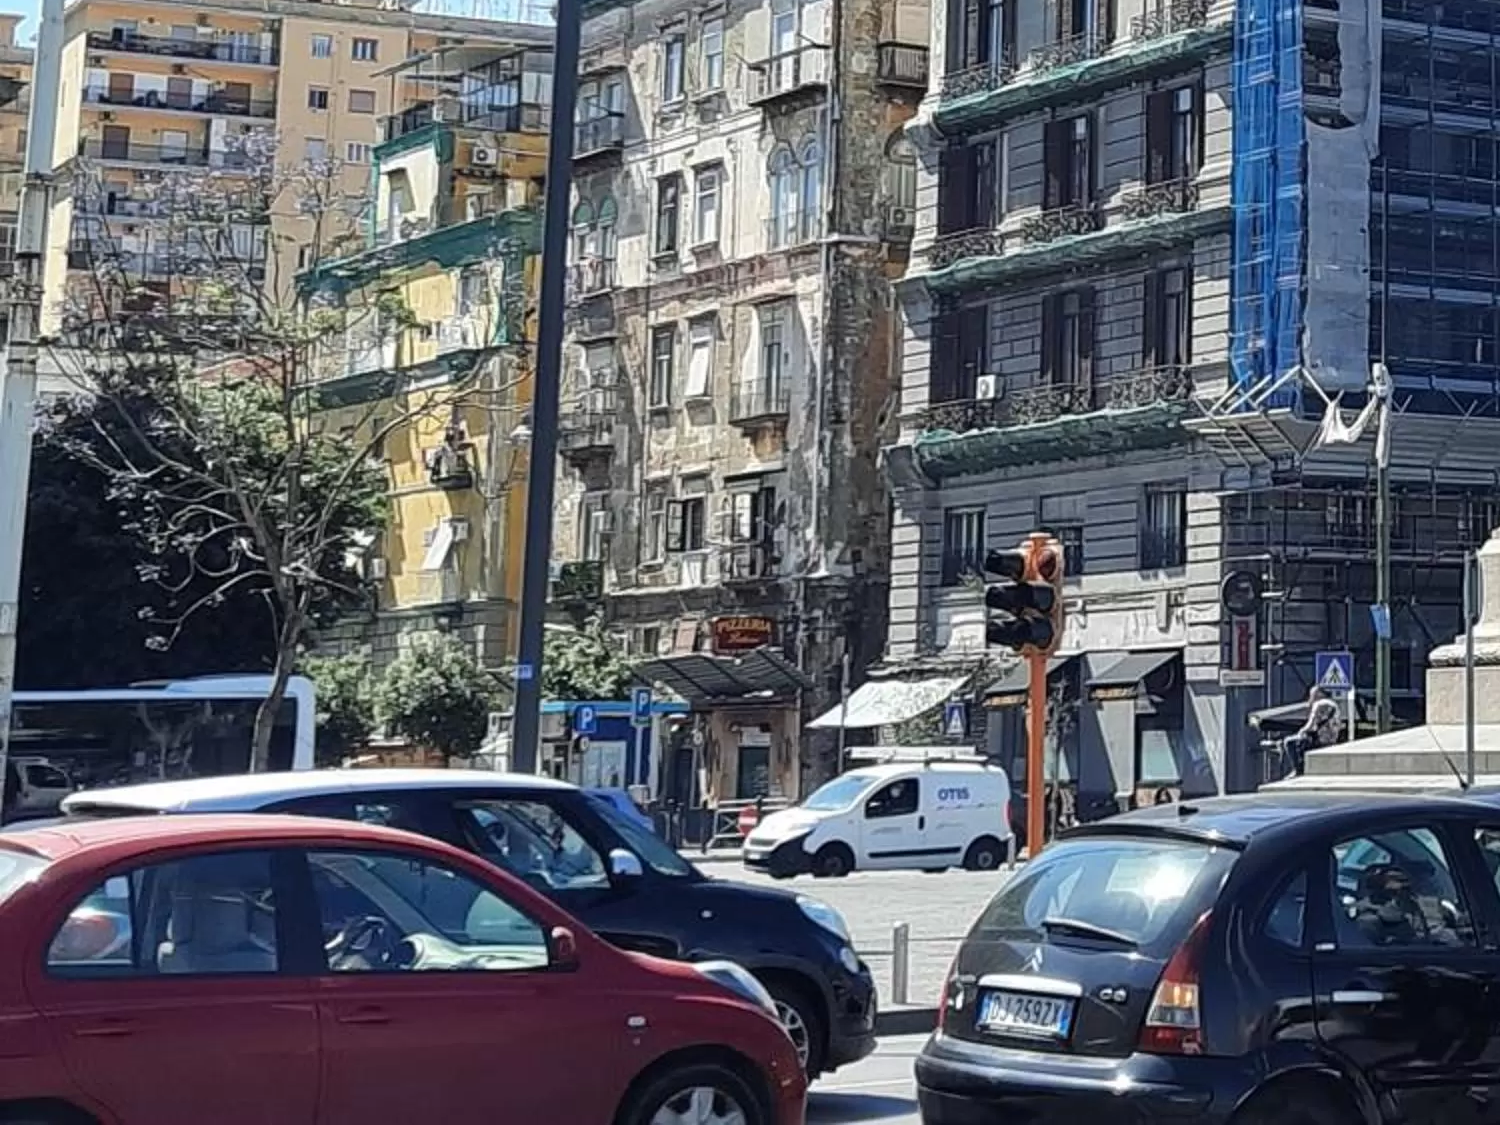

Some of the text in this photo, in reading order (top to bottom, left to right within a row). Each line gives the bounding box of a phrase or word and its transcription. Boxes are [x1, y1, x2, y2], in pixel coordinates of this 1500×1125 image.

[716, 618, 772, 633] PIZZERIA
[638, 692, 649, 712] P
[581, 706, 593, 730] P
[937, 787, 970, 801] OTIS
